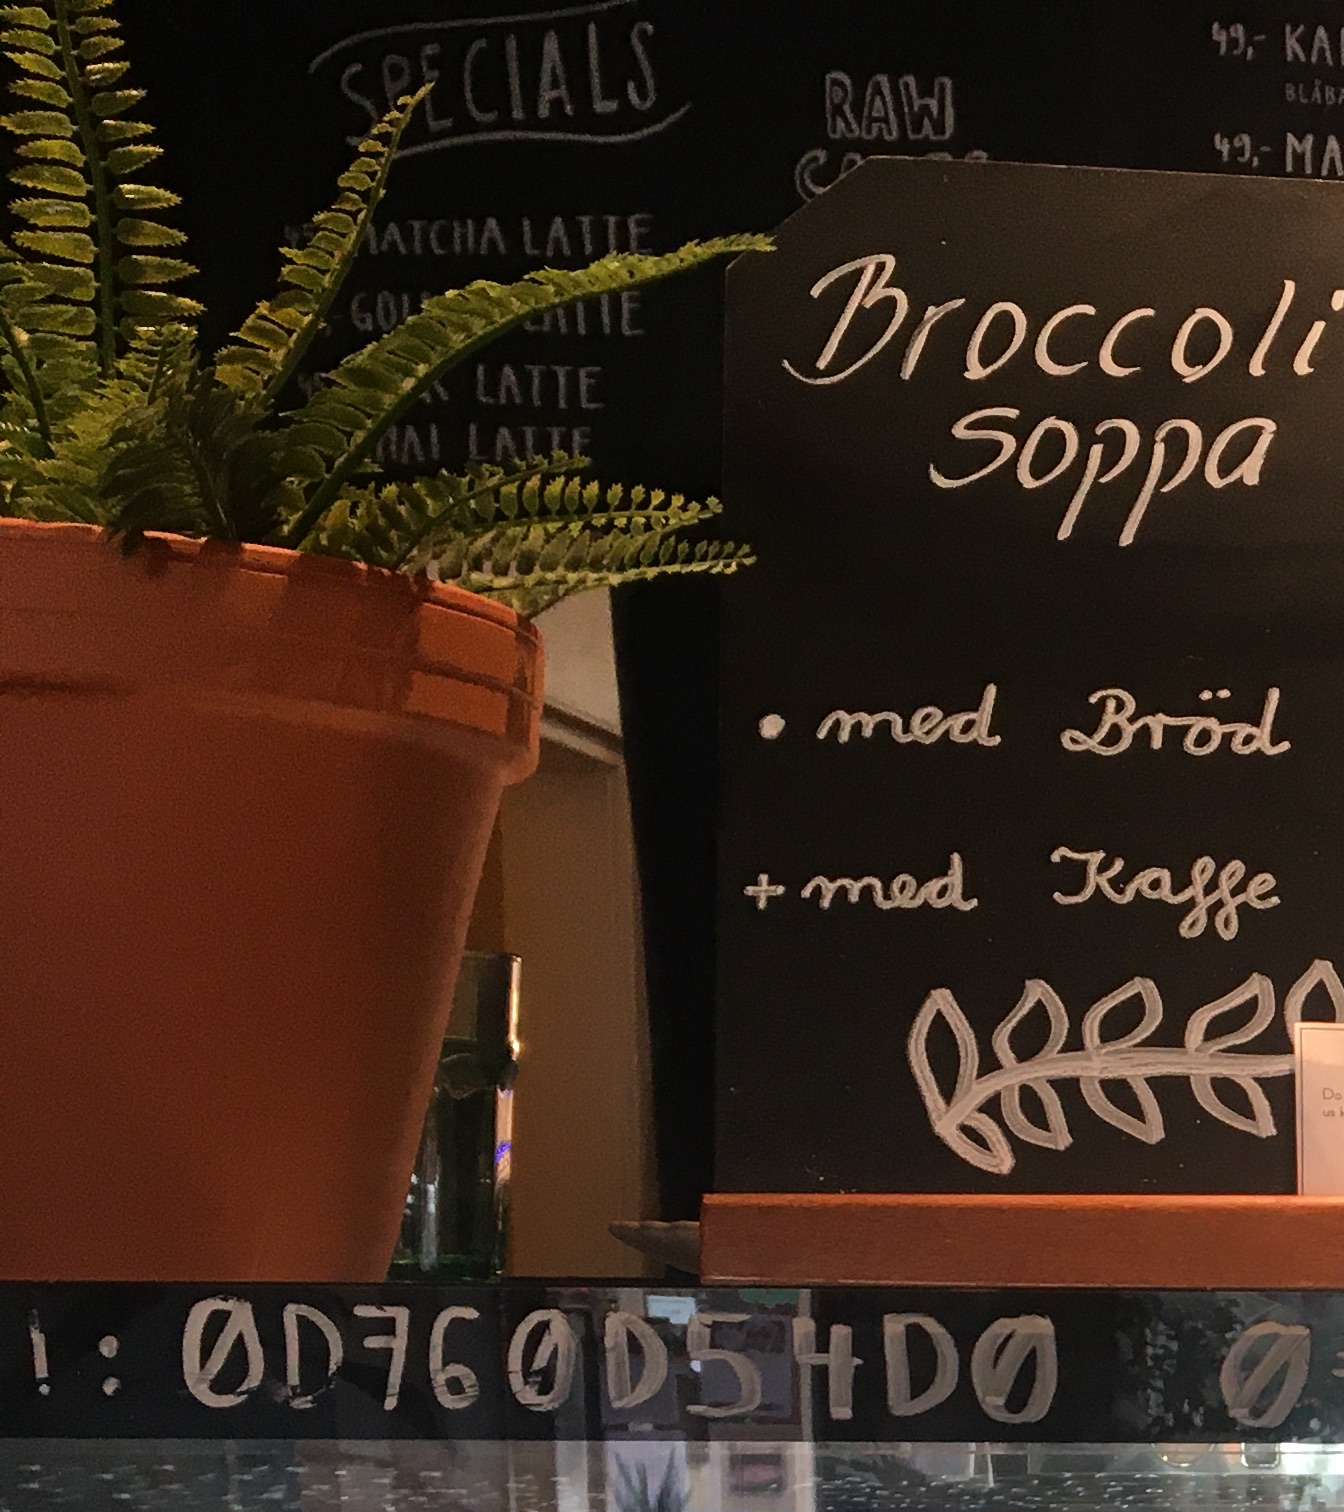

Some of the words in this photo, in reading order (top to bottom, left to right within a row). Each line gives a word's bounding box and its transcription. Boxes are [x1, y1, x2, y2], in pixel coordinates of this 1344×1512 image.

[339, 20, 657, 133] SPECIALS
[825, 71, 955, 140] RAW
[523, 213, 654, 257] LATTE
[476, 362, 606, 411] LATTE
[468, 421, 591, 463] LATTE
[929, 405, 1278, 548] soppa
[816, 683, 1002, 746] med
[1060, 687, 1291, 757] Bröd
[800, 853, 979, 911] med
[1051, 846, 1282, 940] Kaffe
[1322, 1087, 1342, 1101] Do
[1322, 1109, 1336, 1118] us
